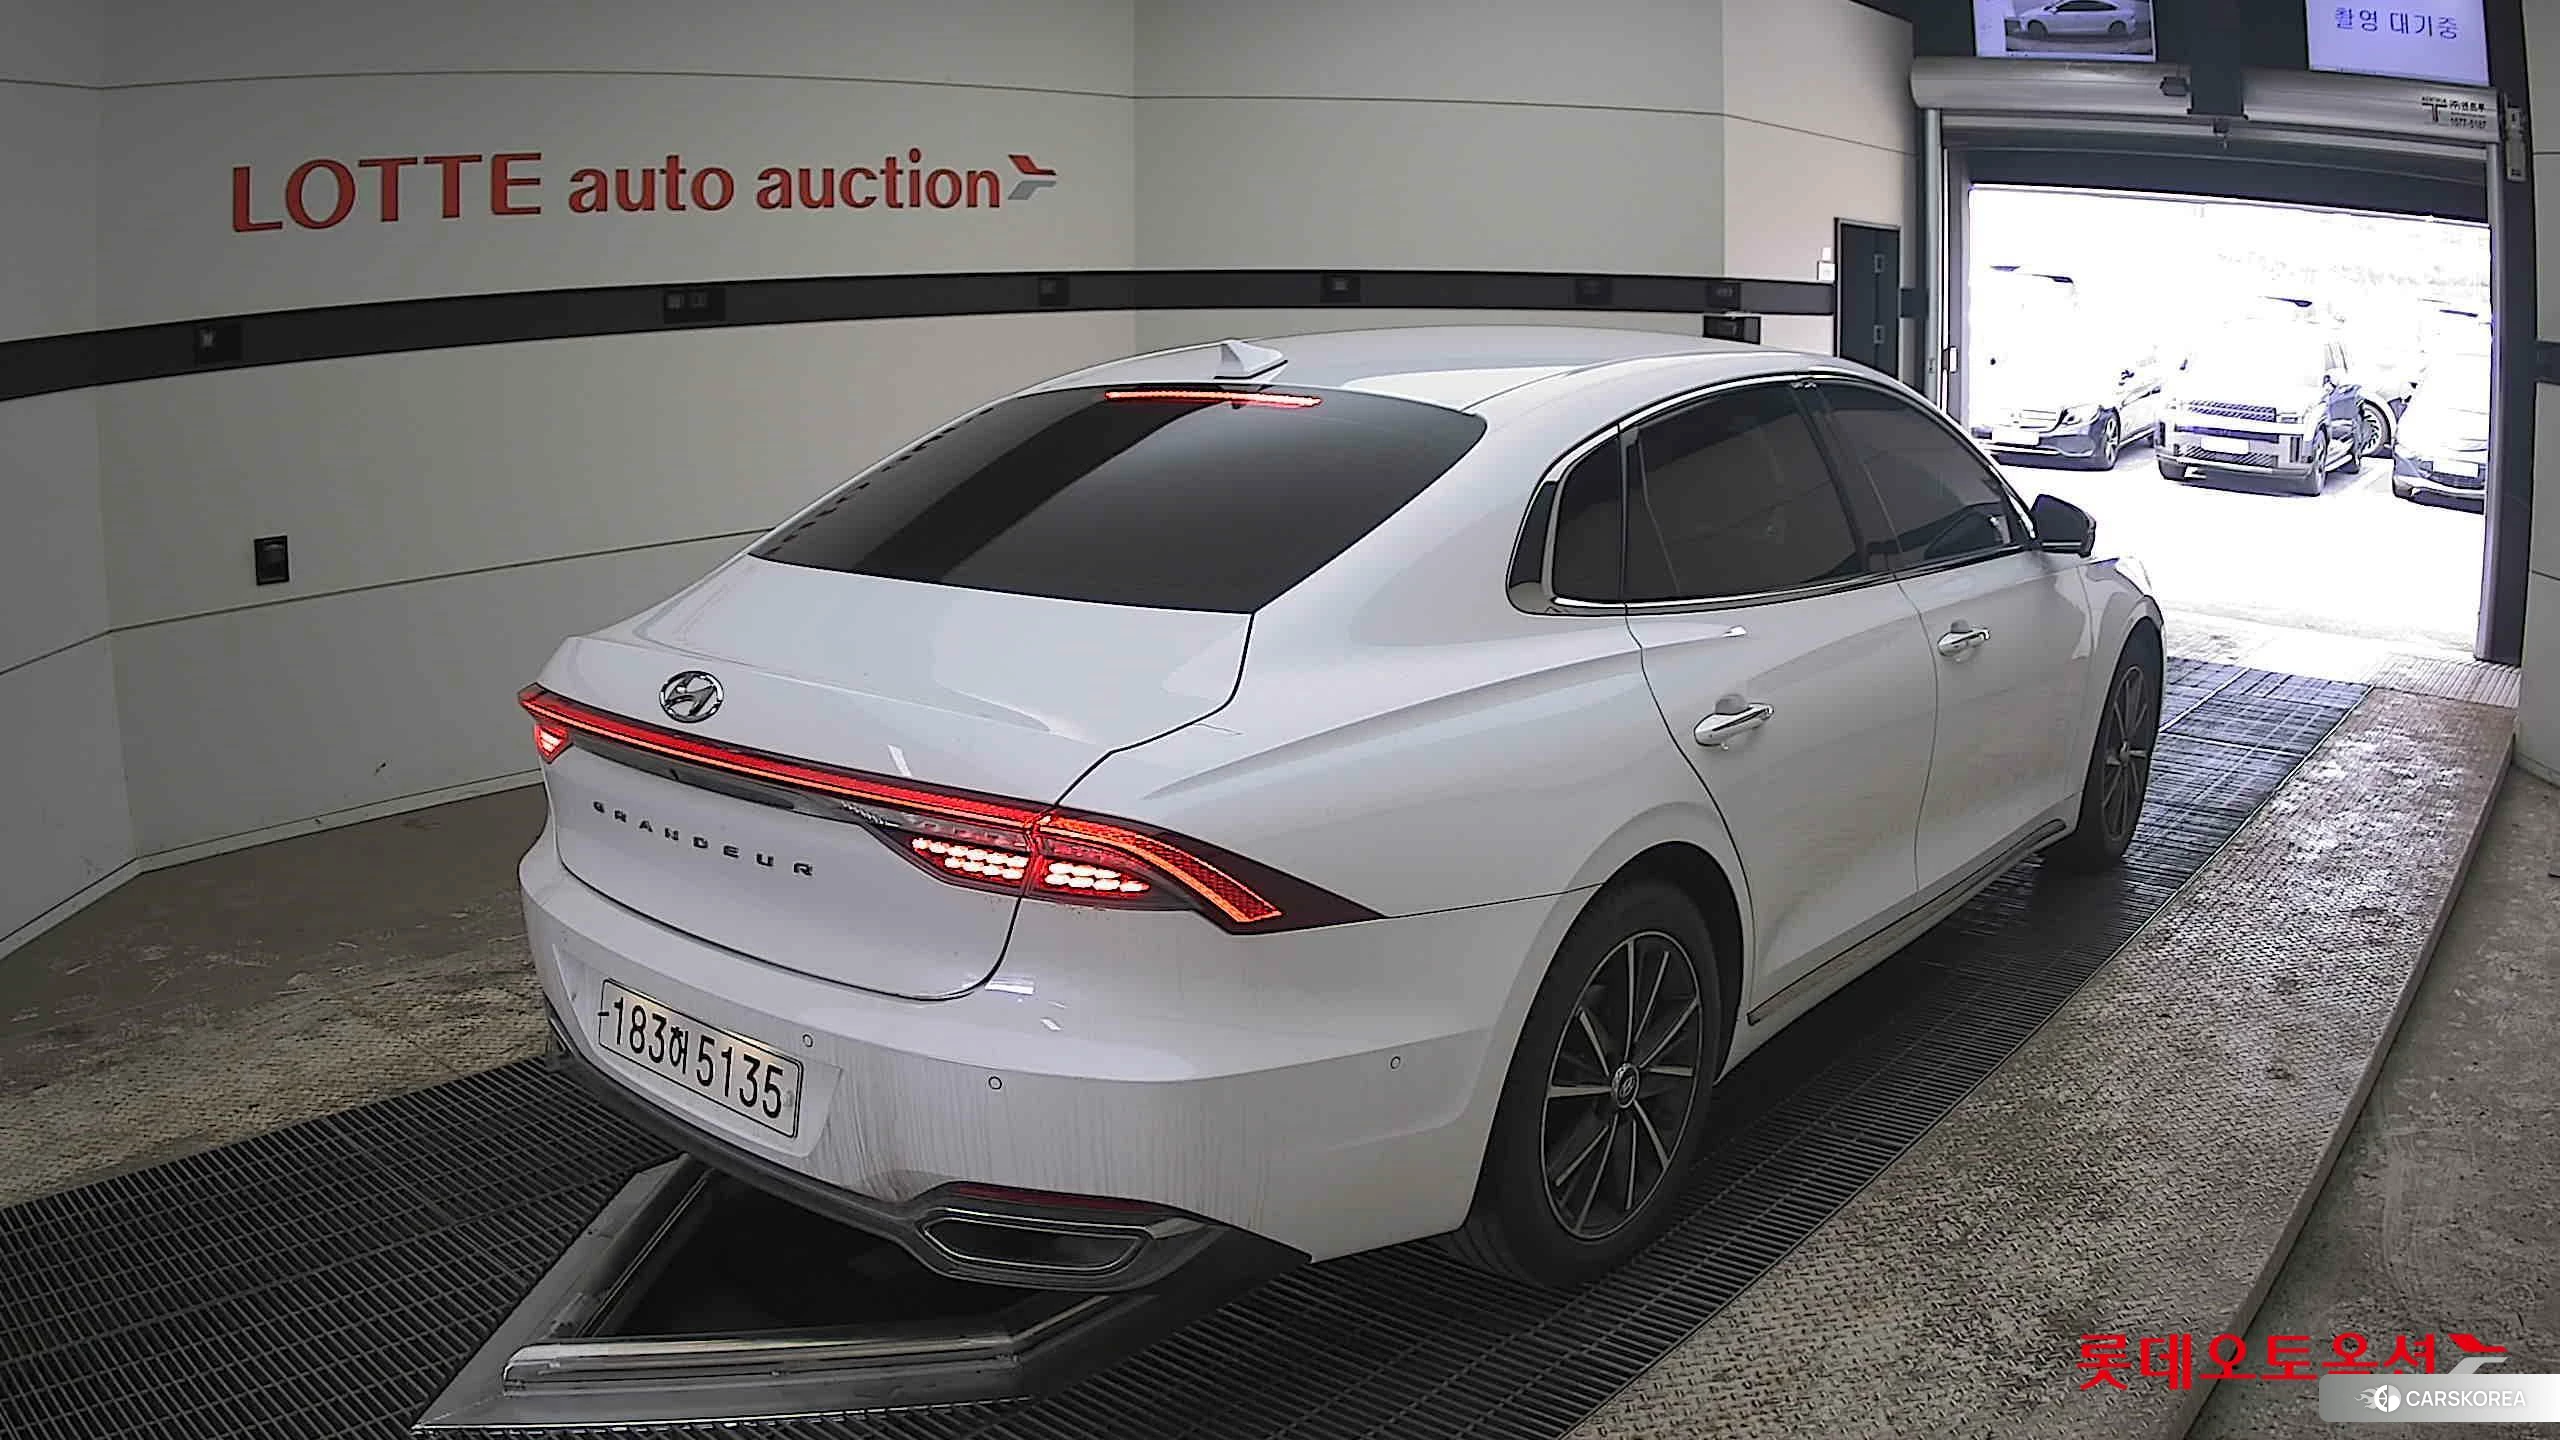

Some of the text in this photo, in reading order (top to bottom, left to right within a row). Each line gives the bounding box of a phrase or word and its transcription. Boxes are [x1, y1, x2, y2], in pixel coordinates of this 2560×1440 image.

[2390, 12, 2457, 40] 대기중
[232, 147, 1001, 233] LOTTE auto auction
[592, 800, 814, 877] GRANDEUR
